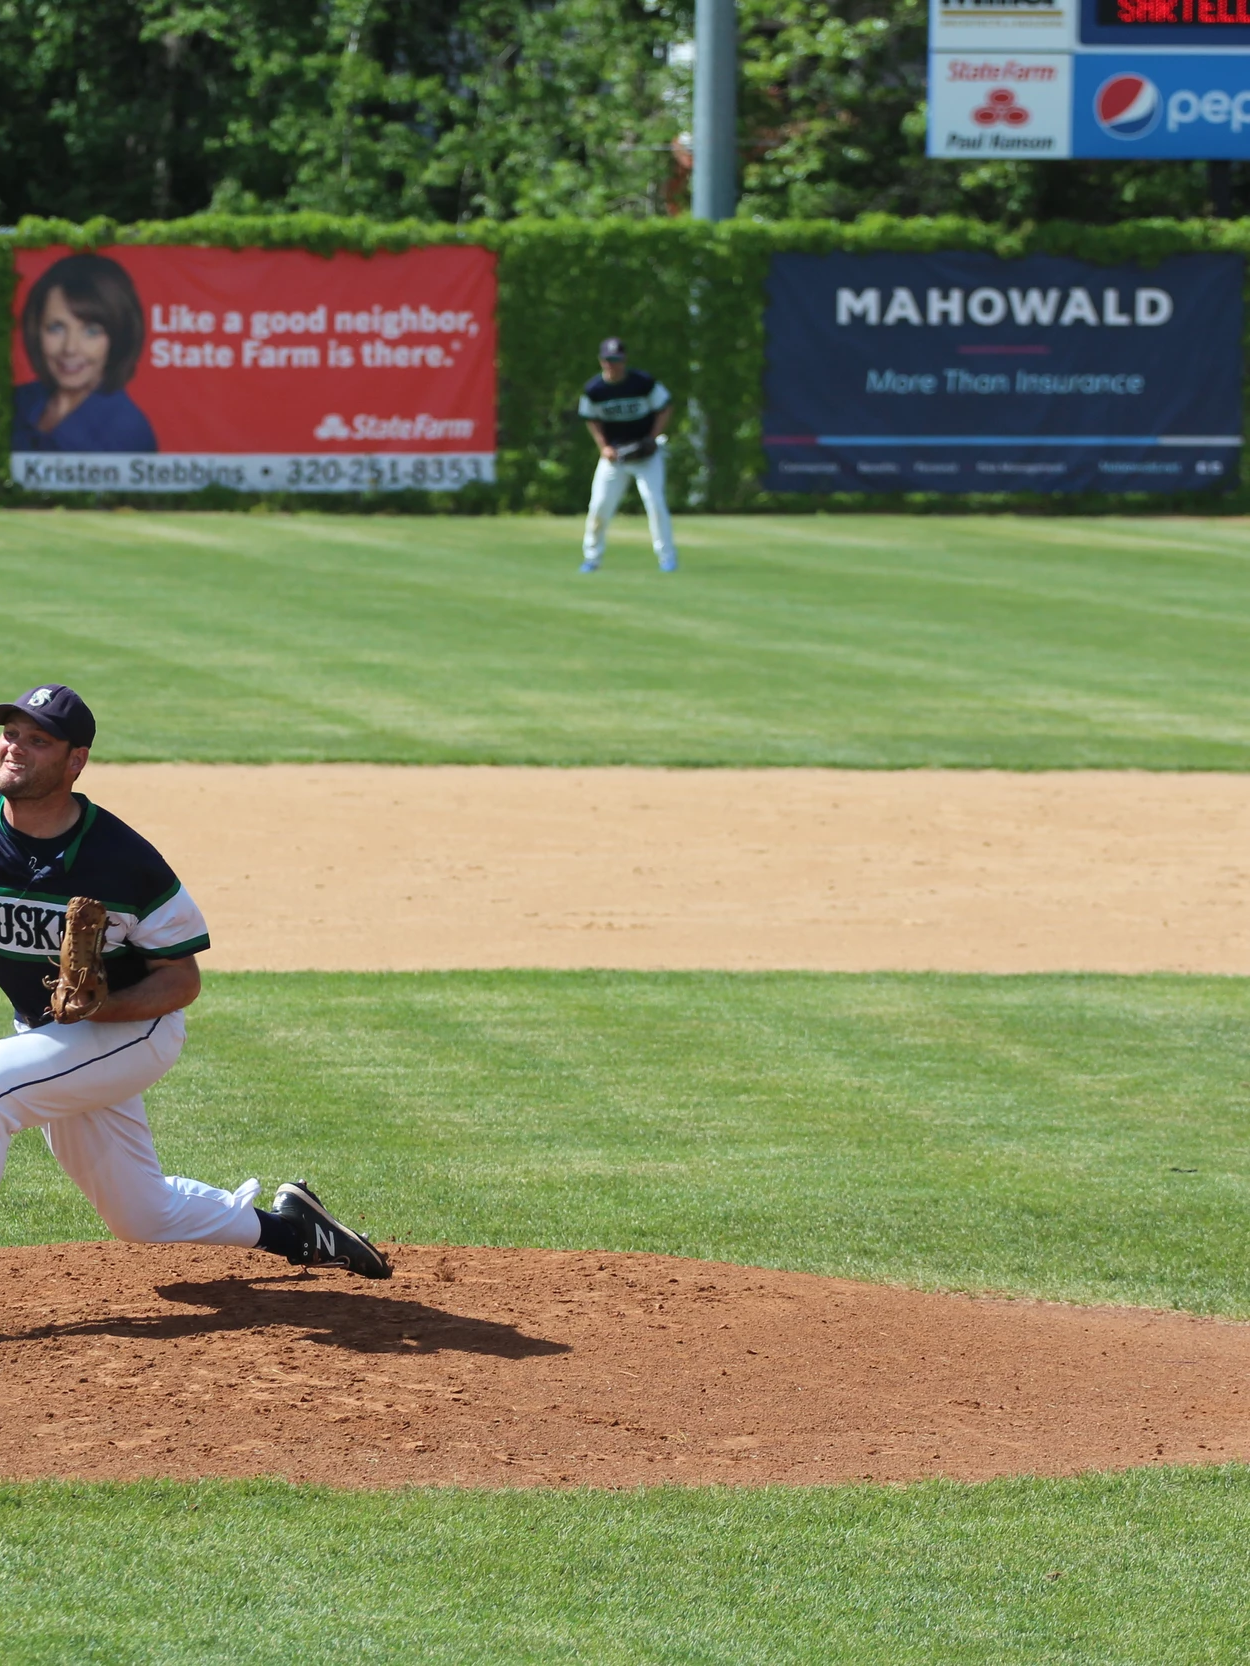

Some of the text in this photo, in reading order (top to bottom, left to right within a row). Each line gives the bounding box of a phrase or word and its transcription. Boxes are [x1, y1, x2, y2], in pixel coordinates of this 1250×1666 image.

[151, 304, 479, 339] Like a good neighbor,
[835, 287, 1174, 326] MAHOWALD
[151, 338, 234, 368] State
[241, 338, 321, 368] Farm
[327, 338, 355, 368] is
[866, 368, 1145, 394] More Than Insurance
[23, 457, 120, 483] Kristen
[129, 457, 247, 484] Stebbins
